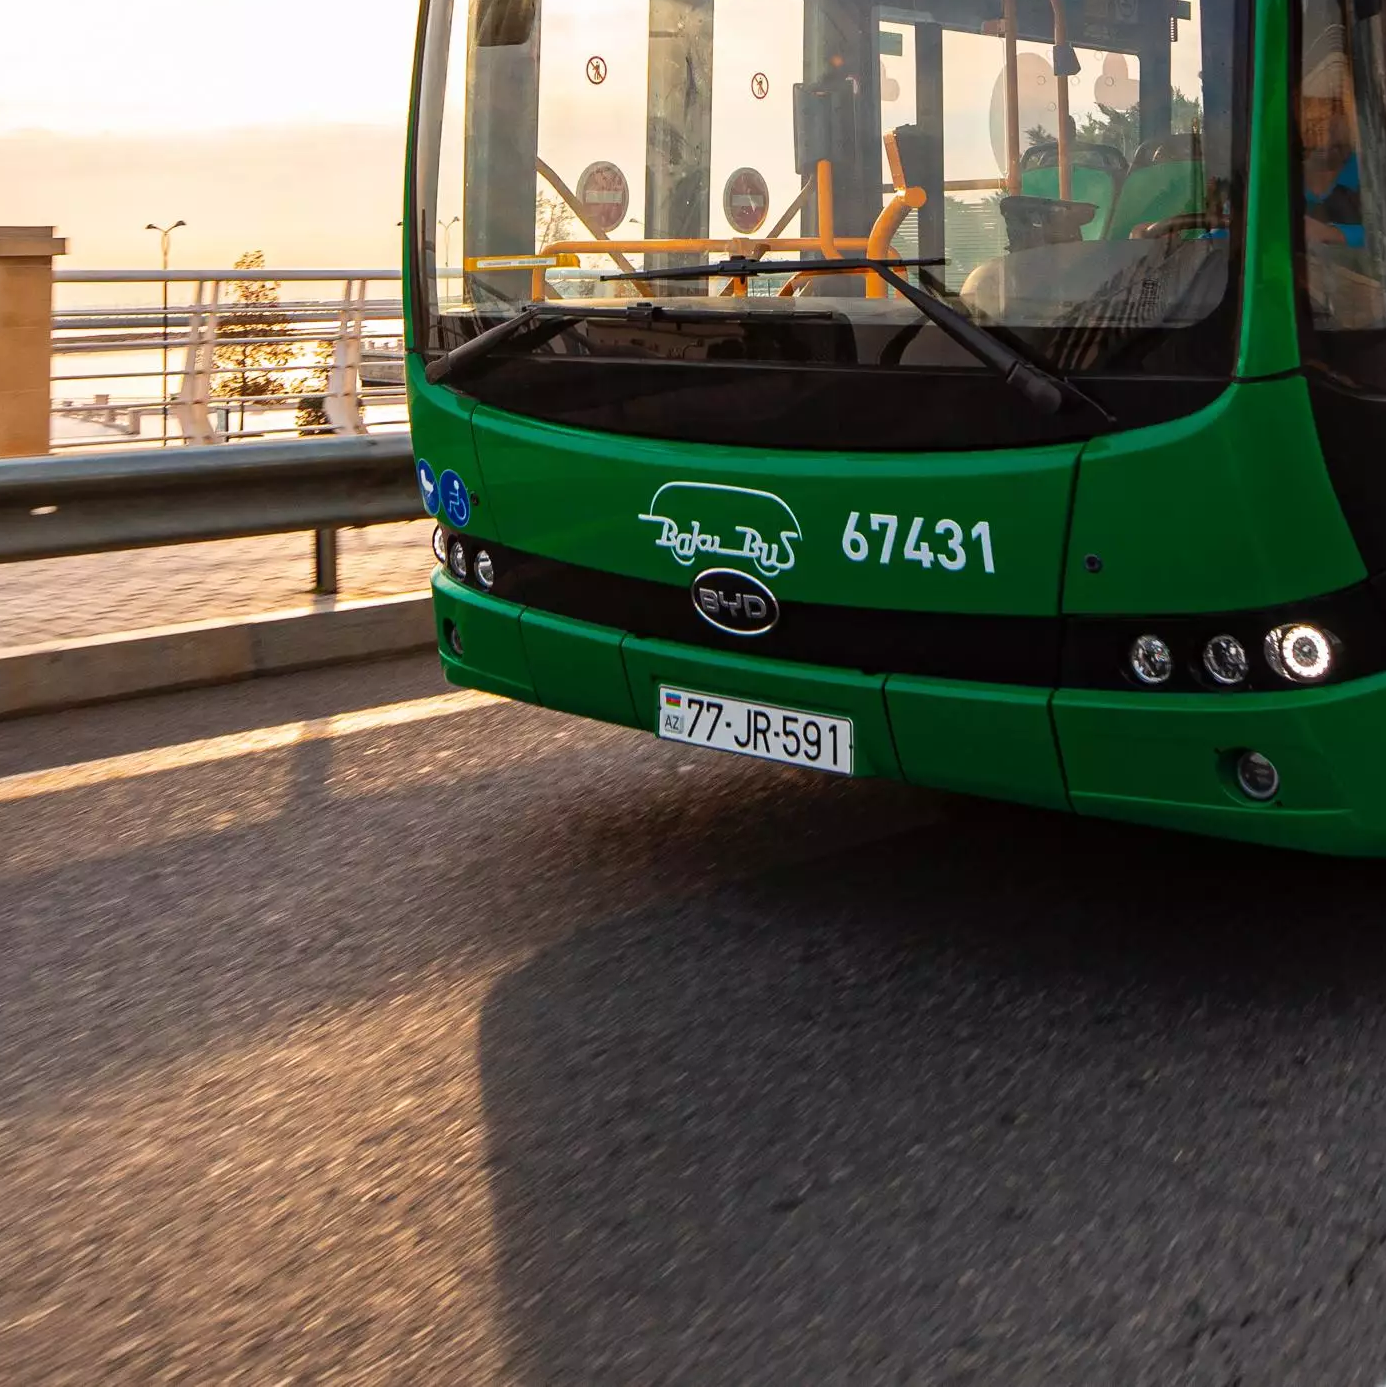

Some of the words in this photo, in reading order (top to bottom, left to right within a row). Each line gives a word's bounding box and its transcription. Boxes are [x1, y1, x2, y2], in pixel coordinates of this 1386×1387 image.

[638, 513, 721, 557] Baku
[842, 511, 995, 574] 67431
[699, 587, 767, 619] BYD
[664, 714, 680, 730] AZ
[687, 697, 838, 766] 77-JR-591
